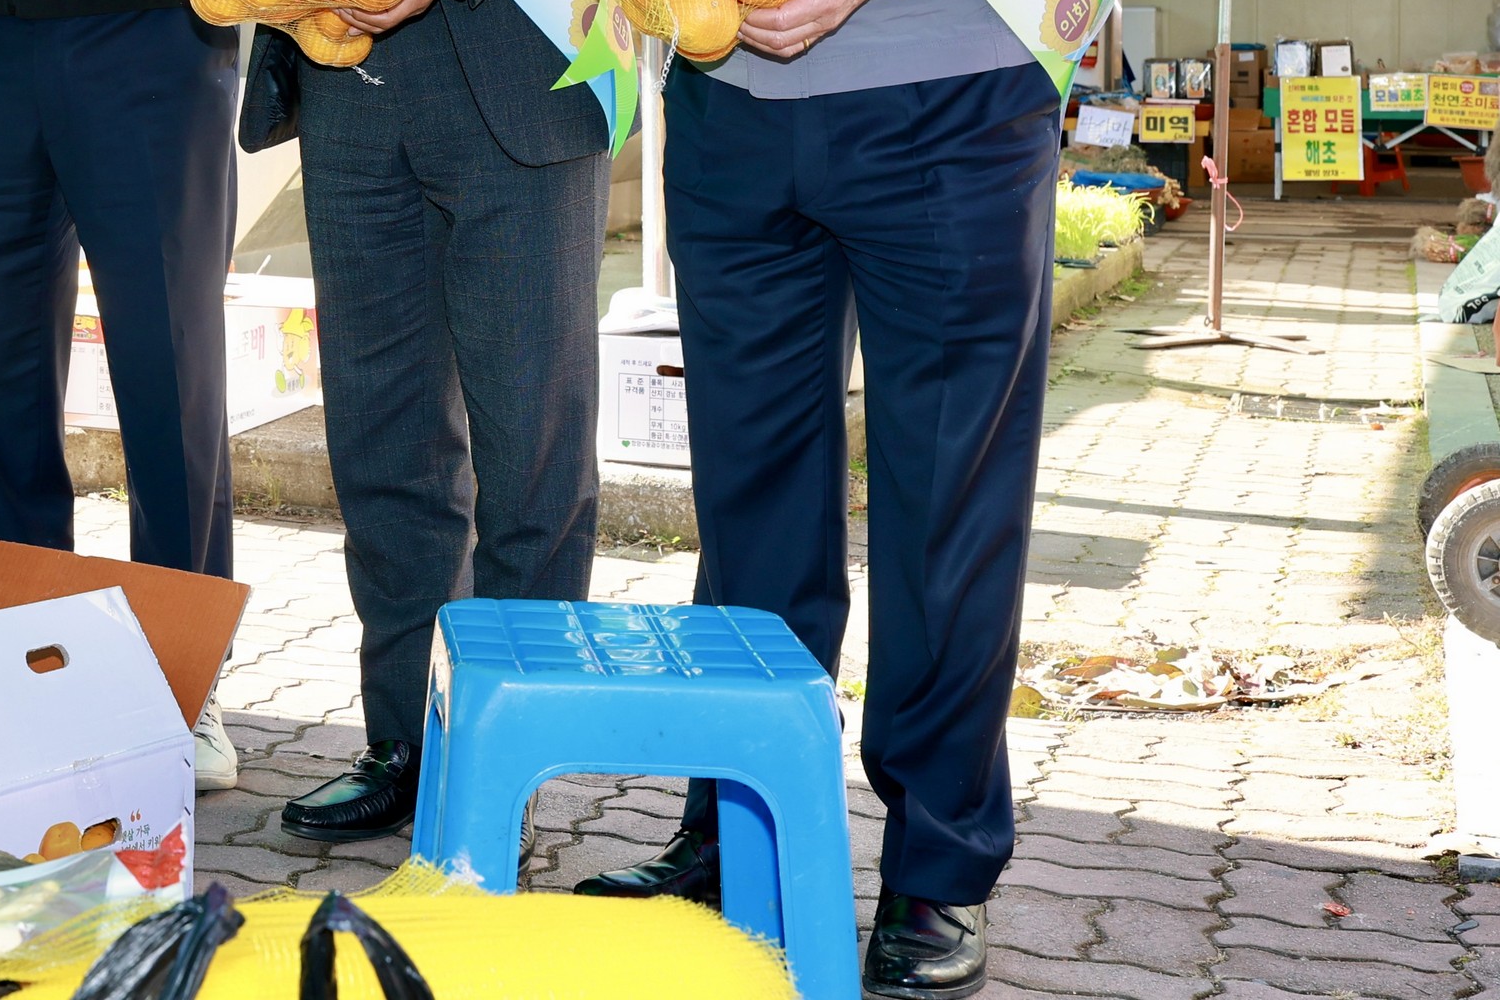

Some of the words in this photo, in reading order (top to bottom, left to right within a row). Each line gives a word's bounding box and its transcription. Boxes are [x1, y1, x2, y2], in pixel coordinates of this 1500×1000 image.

[1145, 116, 1189, 133] 미역
[1287, 109, 1318, 134] 혼합
[1324, 109, 1355, 134] 모듬
[1305, 140, 1337, 165] 해초
[651, 390, 663, 398] 산지
[670, 423, 686, 432] 10kg
